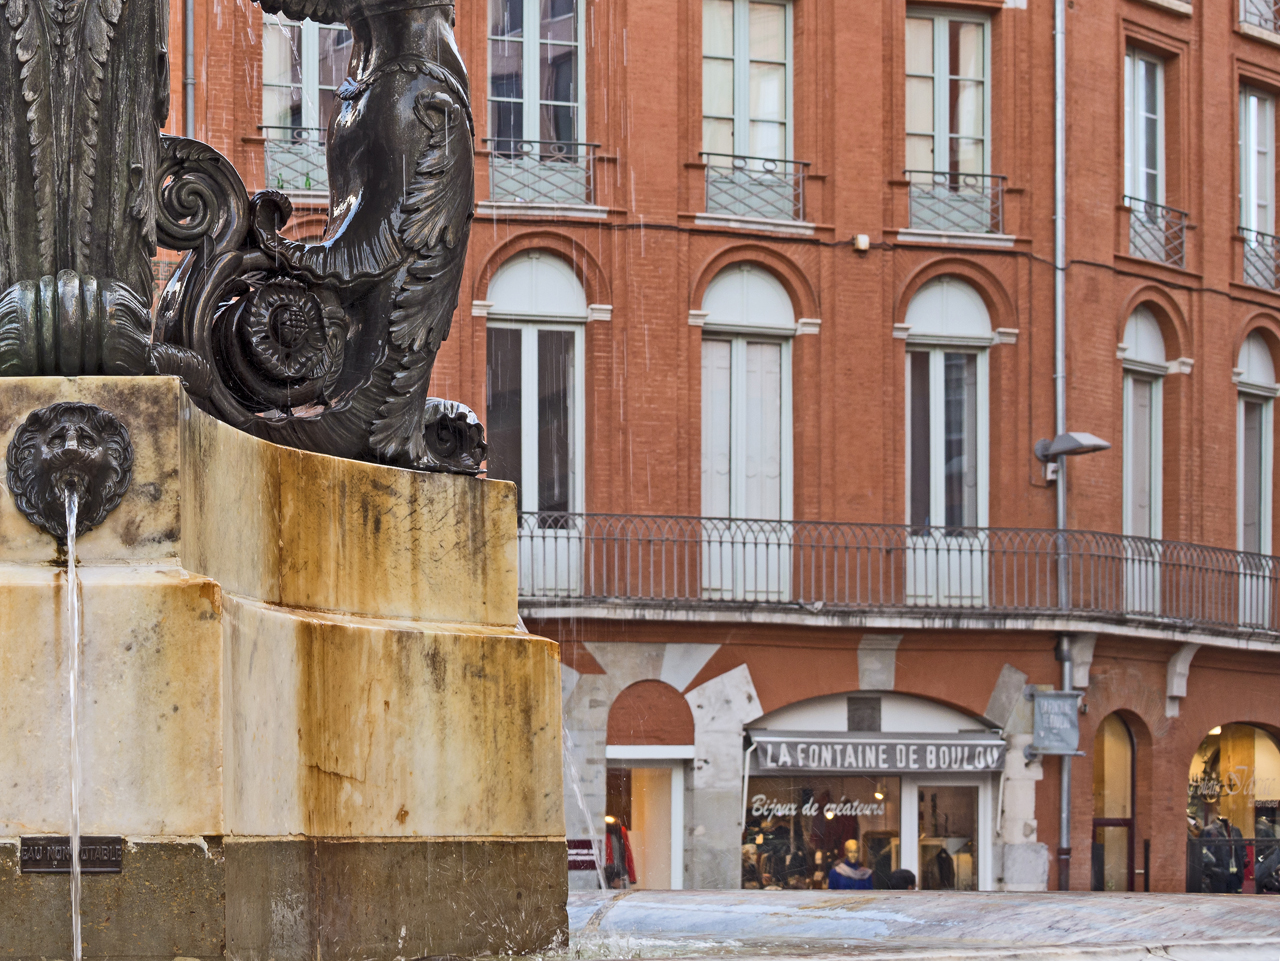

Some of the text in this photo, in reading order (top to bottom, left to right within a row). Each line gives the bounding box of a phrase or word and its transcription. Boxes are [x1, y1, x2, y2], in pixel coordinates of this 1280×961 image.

[766, 743, 791, 767] LA
[797, 743, 889, 769] FONTAINE
[896, 744, 920, 769] DE
[751, 794, 886, 822] Bijoux de créateurs
[21, 845, 122, 860] EAU NON OTABLE
